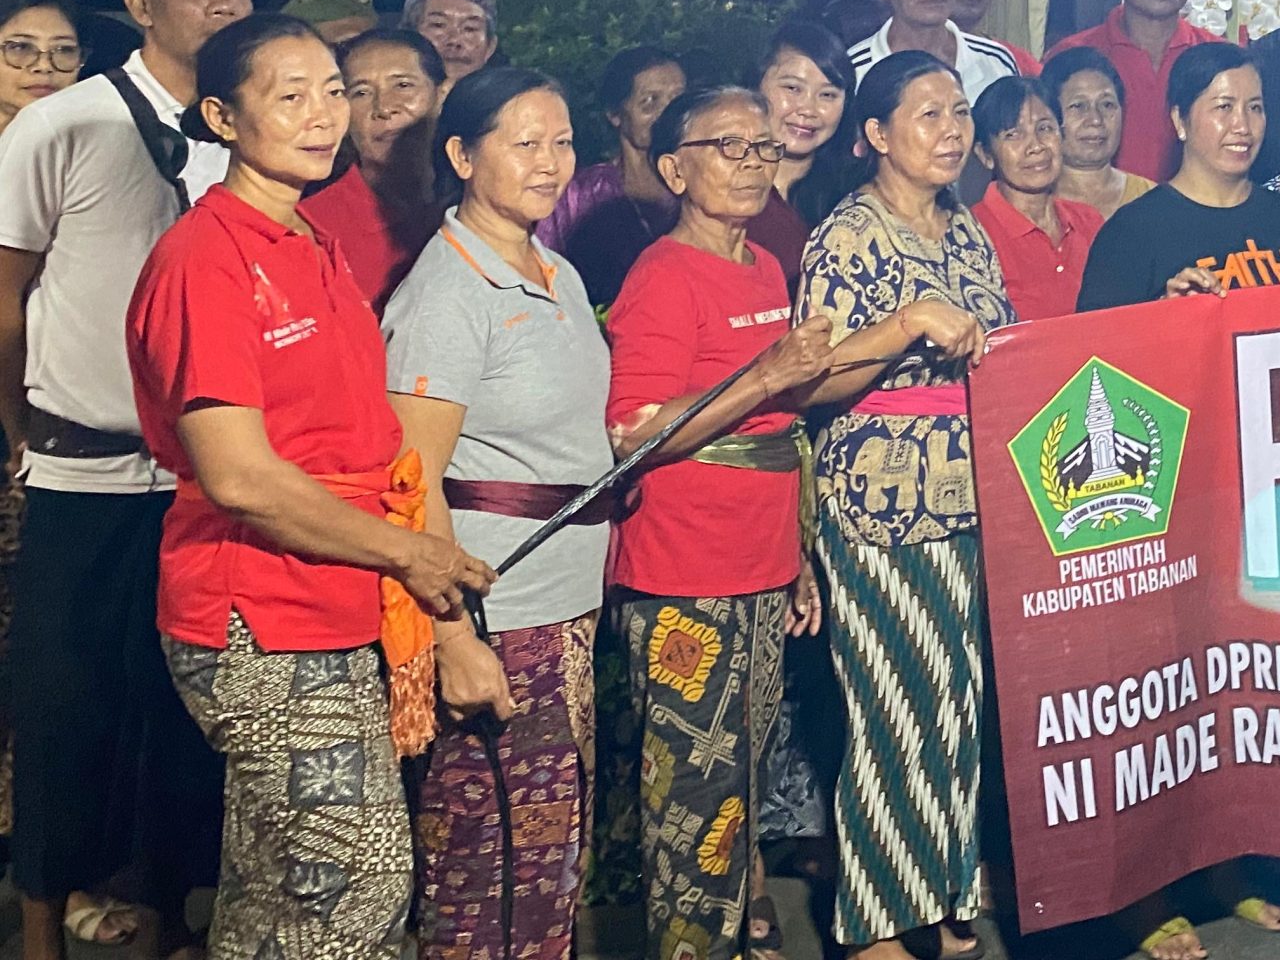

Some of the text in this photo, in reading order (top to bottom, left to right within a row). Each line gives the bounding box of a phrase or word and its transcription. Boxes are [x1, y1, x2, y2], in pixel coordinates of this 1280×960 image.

[1085, 478, 1126, 493] TABANAN
[1022, 555, 1197, 618] KABUPATEN TABANAN
[1059, 539, 1167, 584] PEMERINTAH
[1037, 658, 1198, 746] ANGGOTA
[1042, 759, 1096, 826] NI
[1114, 713, 1219, 813] MADE
